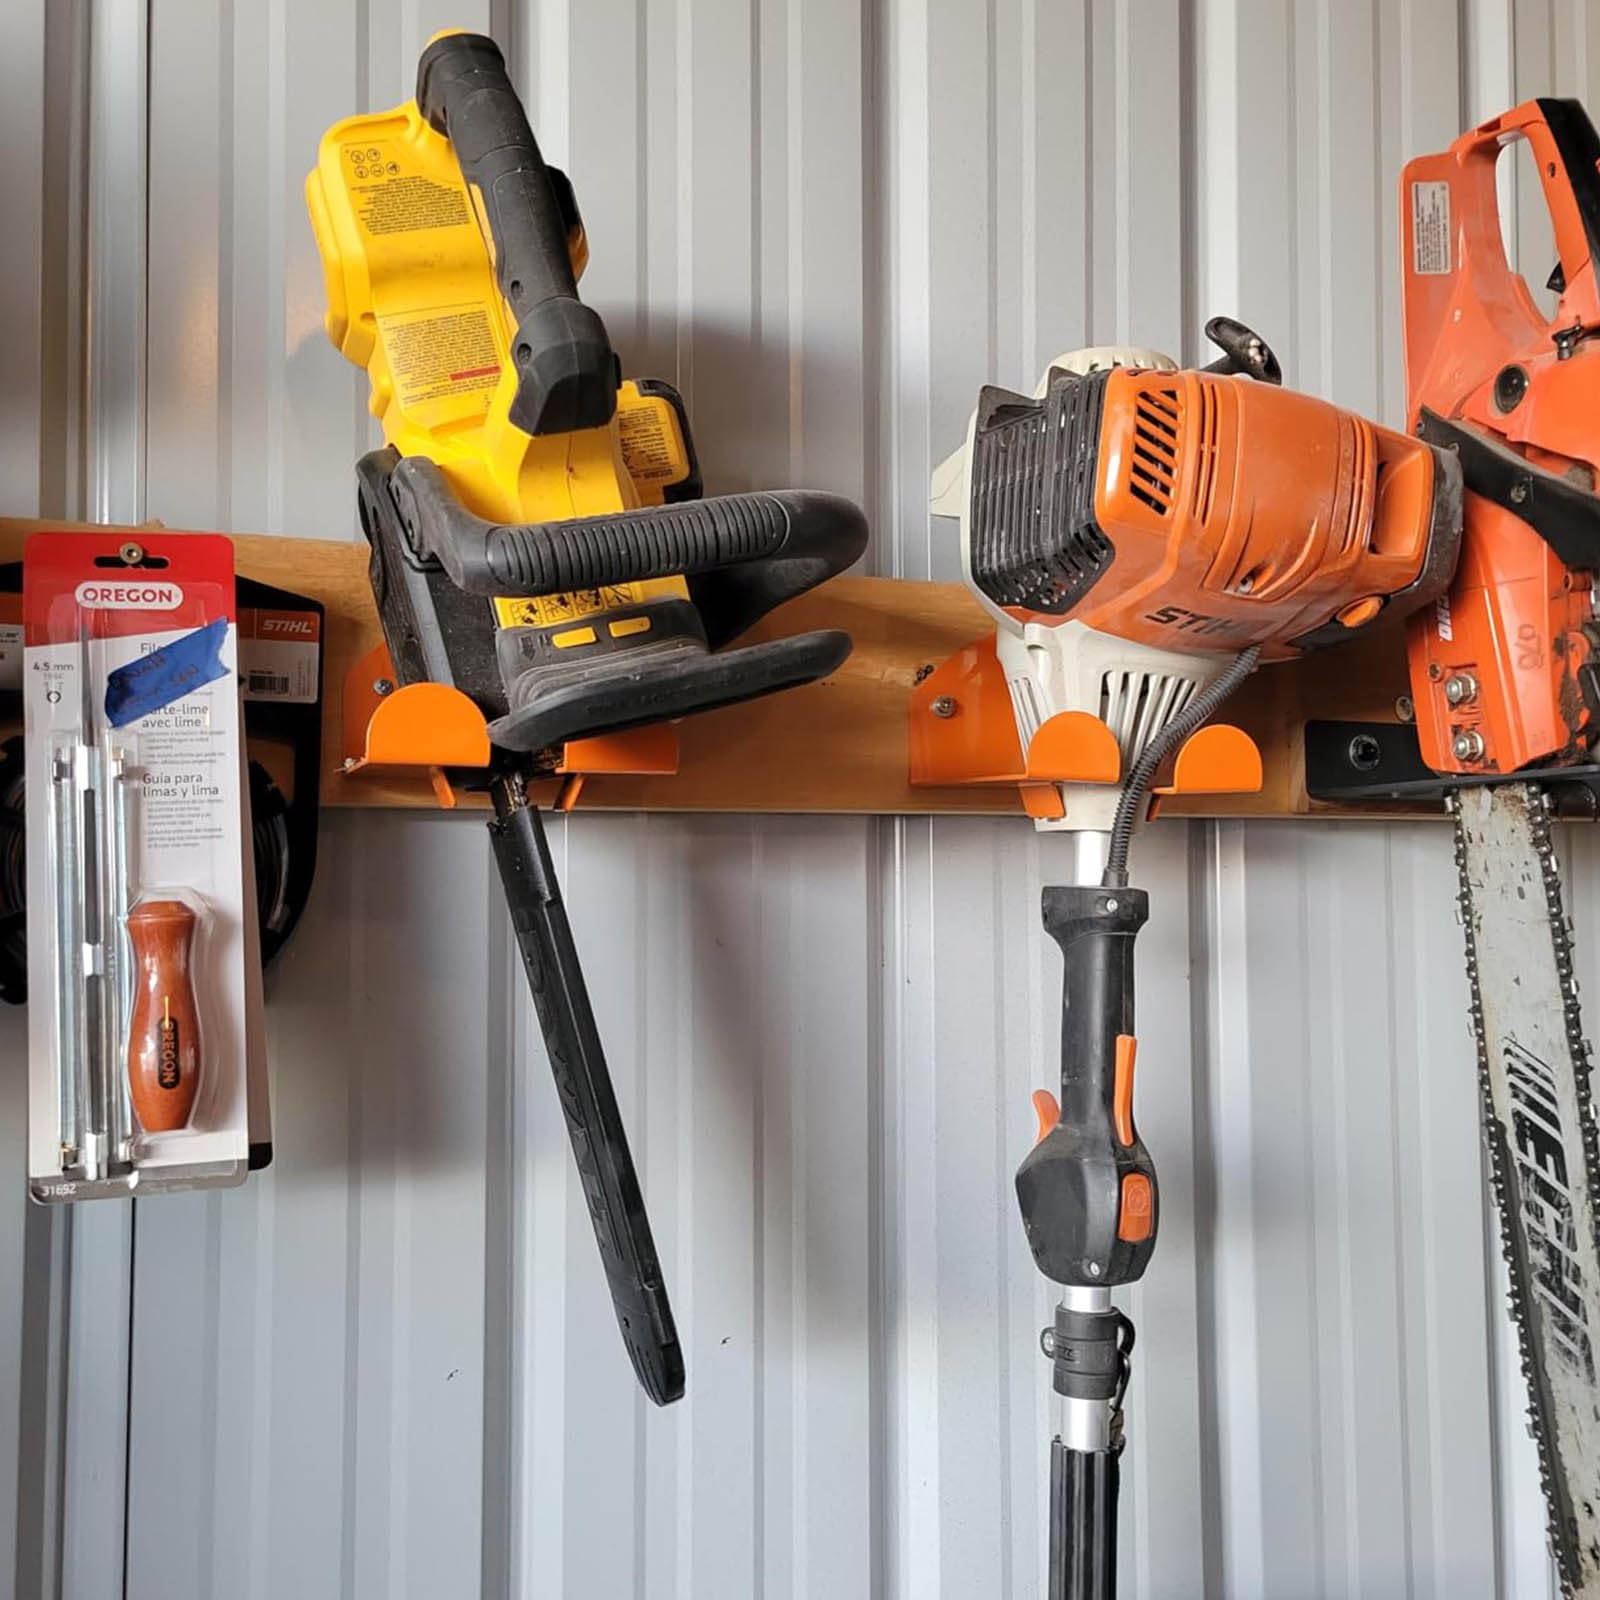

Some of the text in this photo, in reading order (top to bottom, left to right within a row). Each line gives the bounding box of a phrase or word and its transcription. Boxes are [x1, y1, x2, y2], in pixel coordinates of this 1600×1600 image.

[83, 588, 172, 602] OREGON
[263, 620, 312, 633] STIHL
[33, 661, 50, 671] 4.5
[142, 716, 202, 729] avec lime
[174, 774, 203, 786] para
[143, 783, 219, 799] limas y lima
